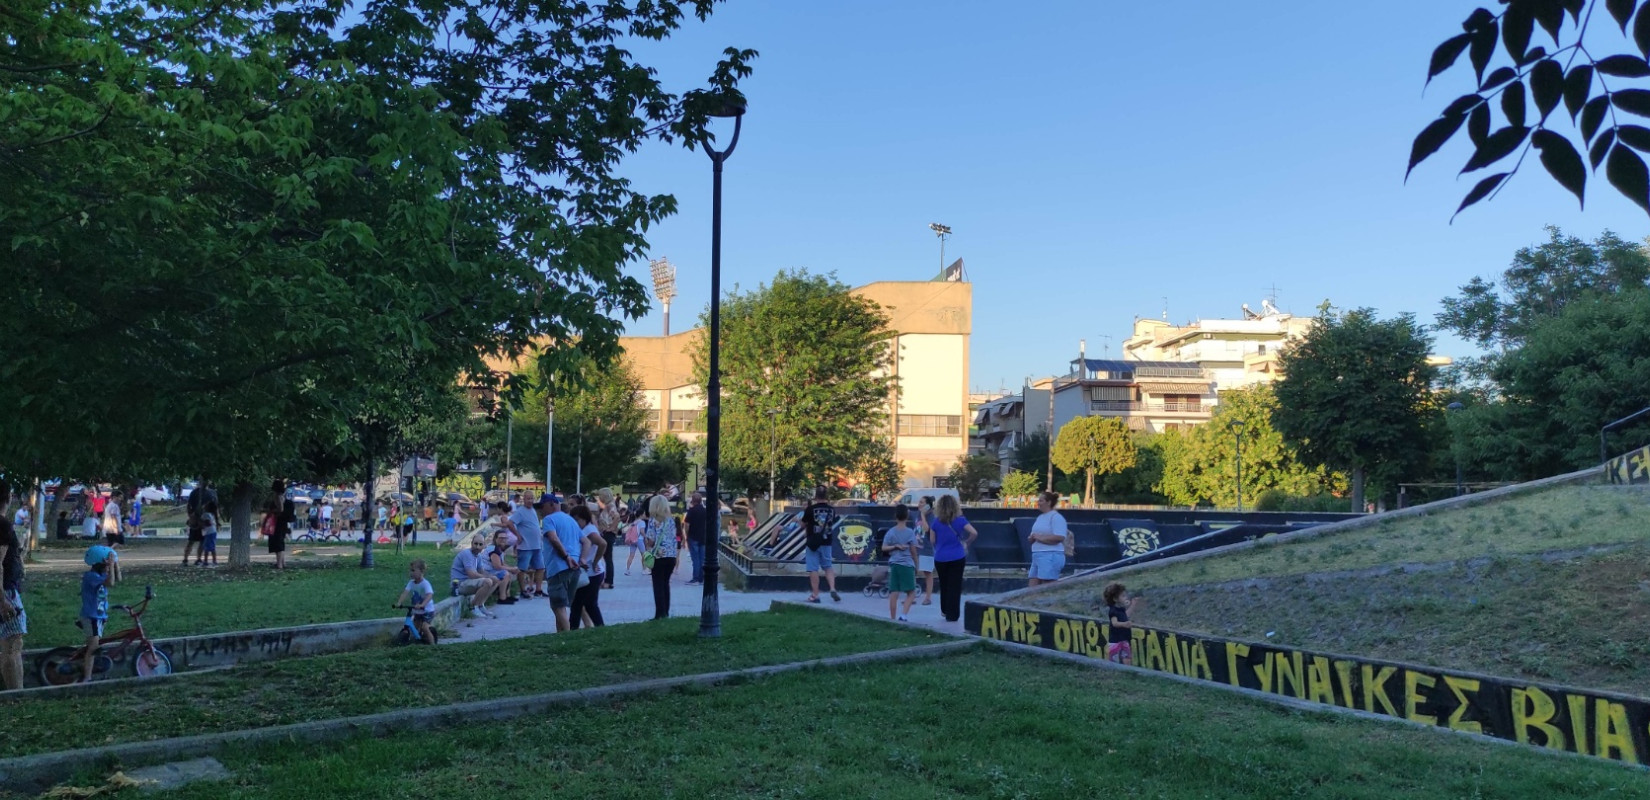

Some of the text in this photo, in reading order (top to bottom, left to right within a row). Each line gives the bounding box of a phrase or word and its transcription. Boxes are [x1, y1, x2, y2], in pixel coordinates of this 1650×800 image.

[981, 607, 1041, 645] ΑΡΗΣ
[1226, 641, 1483, 734] ΓΥΝΑΙΚΕΣ
[1511, 685, 1638, 763] ΒΙΑ
